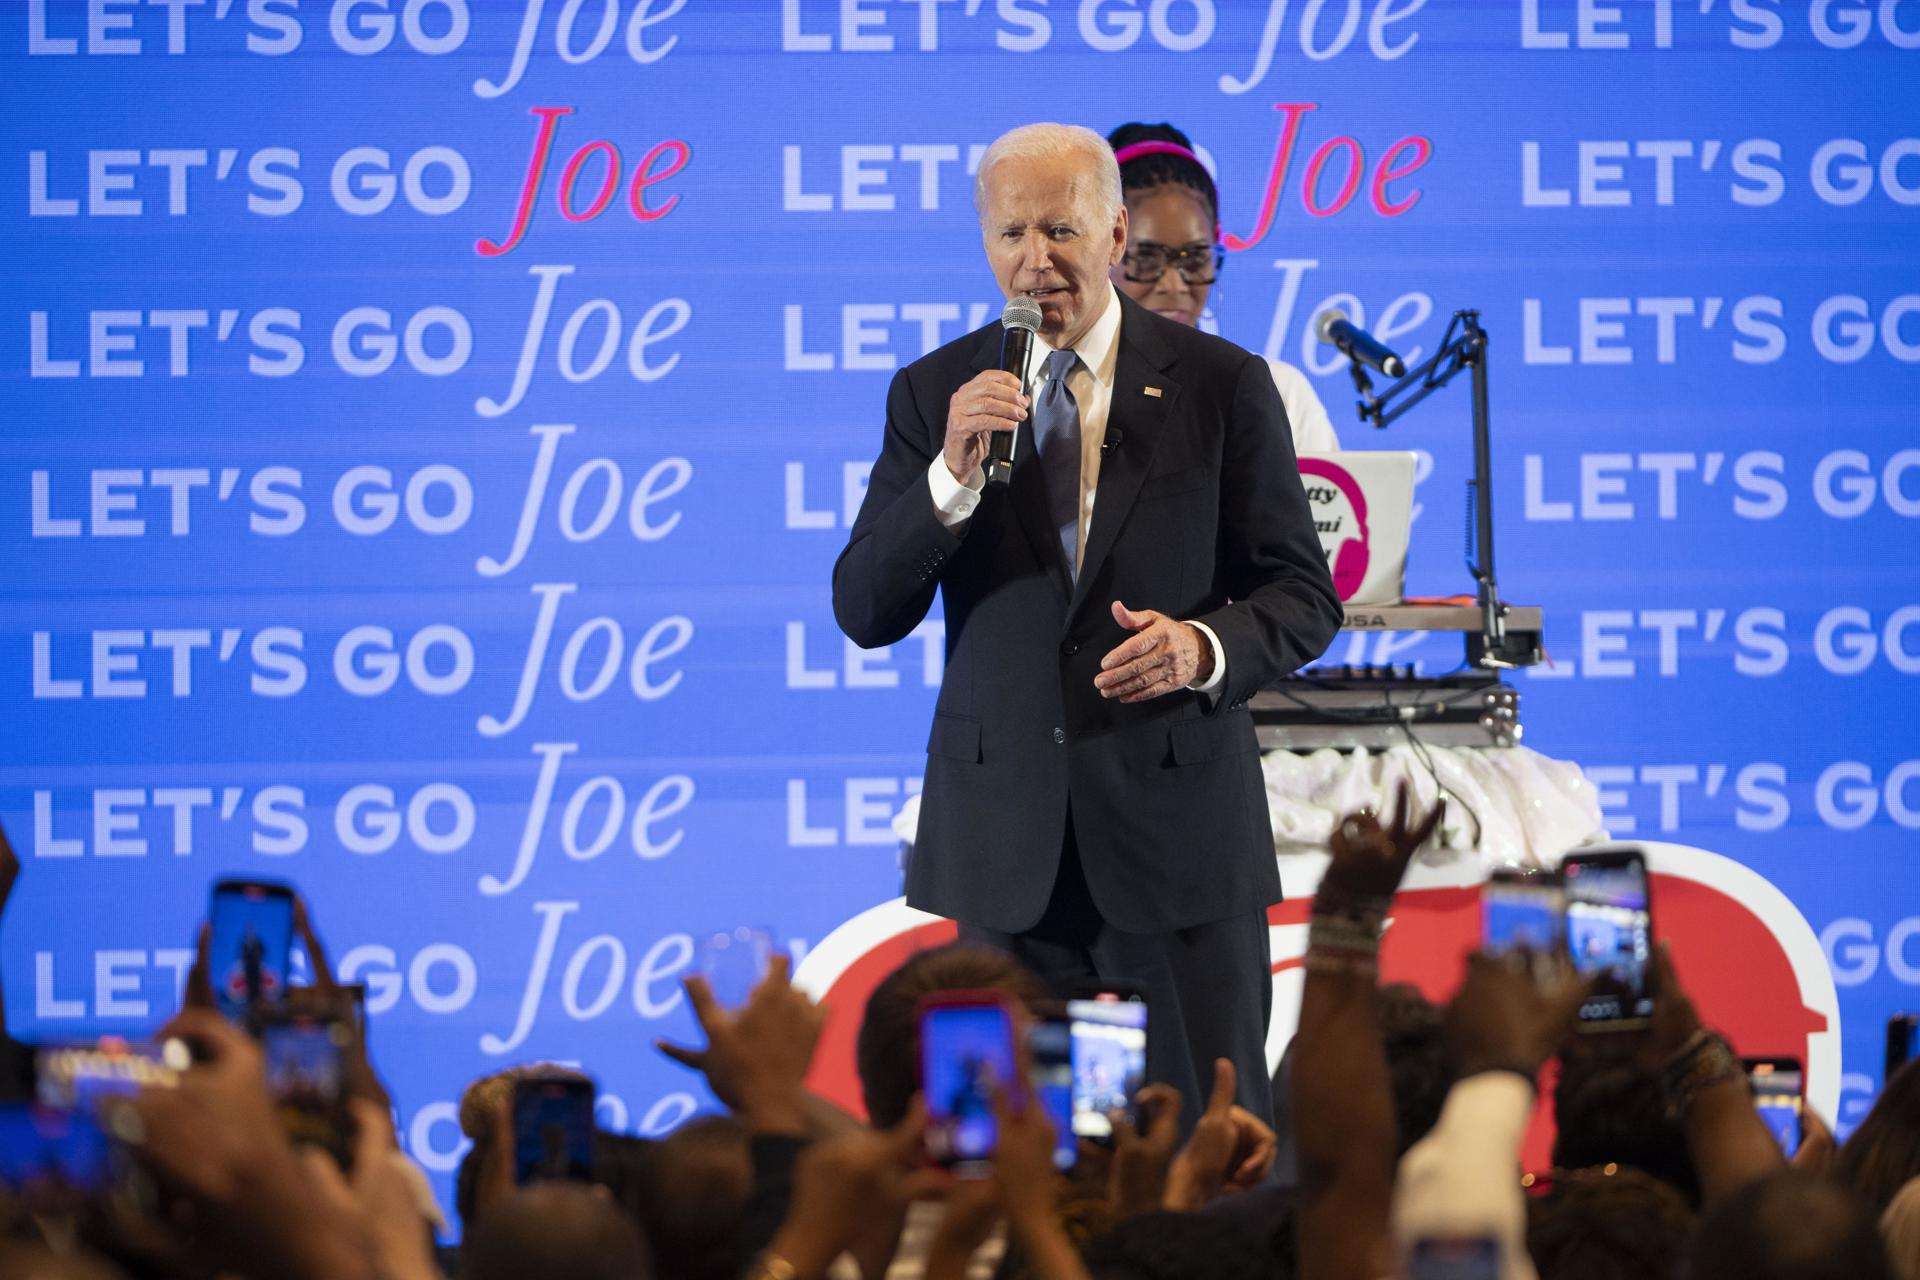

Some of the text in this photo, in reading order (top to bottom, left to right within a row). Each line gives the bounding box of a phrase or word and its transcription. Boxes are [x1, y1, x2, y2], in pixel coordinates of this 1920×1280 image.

[29, 0, 687, 98] LET'S GO Joe
[783, 0, 1425, 94] LET'S GO Joe
[1809, 0, 1920, 48] GO
[30, 106, 691, 256] LET'S GO Joe
[783, 102, 1431, 252] LET' Joe
[1521, 139, 1785, 207] LET'S
[30, 265, 691, 416] LET'S GO Joe
[784, 259, 1433, 376] LET' Joe
[1522, 296, 1787, 364] LET'S
[32, 424, 693, 576] LET'S GO Joe
[1524, 451, 1788, 521] LET'S
[33, 583, 694, 735] LET'S GO Joe
[34, 743, 695, 895] LET'S GO Joe
[336, 944, 478, 1014] GO
[480, 902, 694, 1054] Joe
